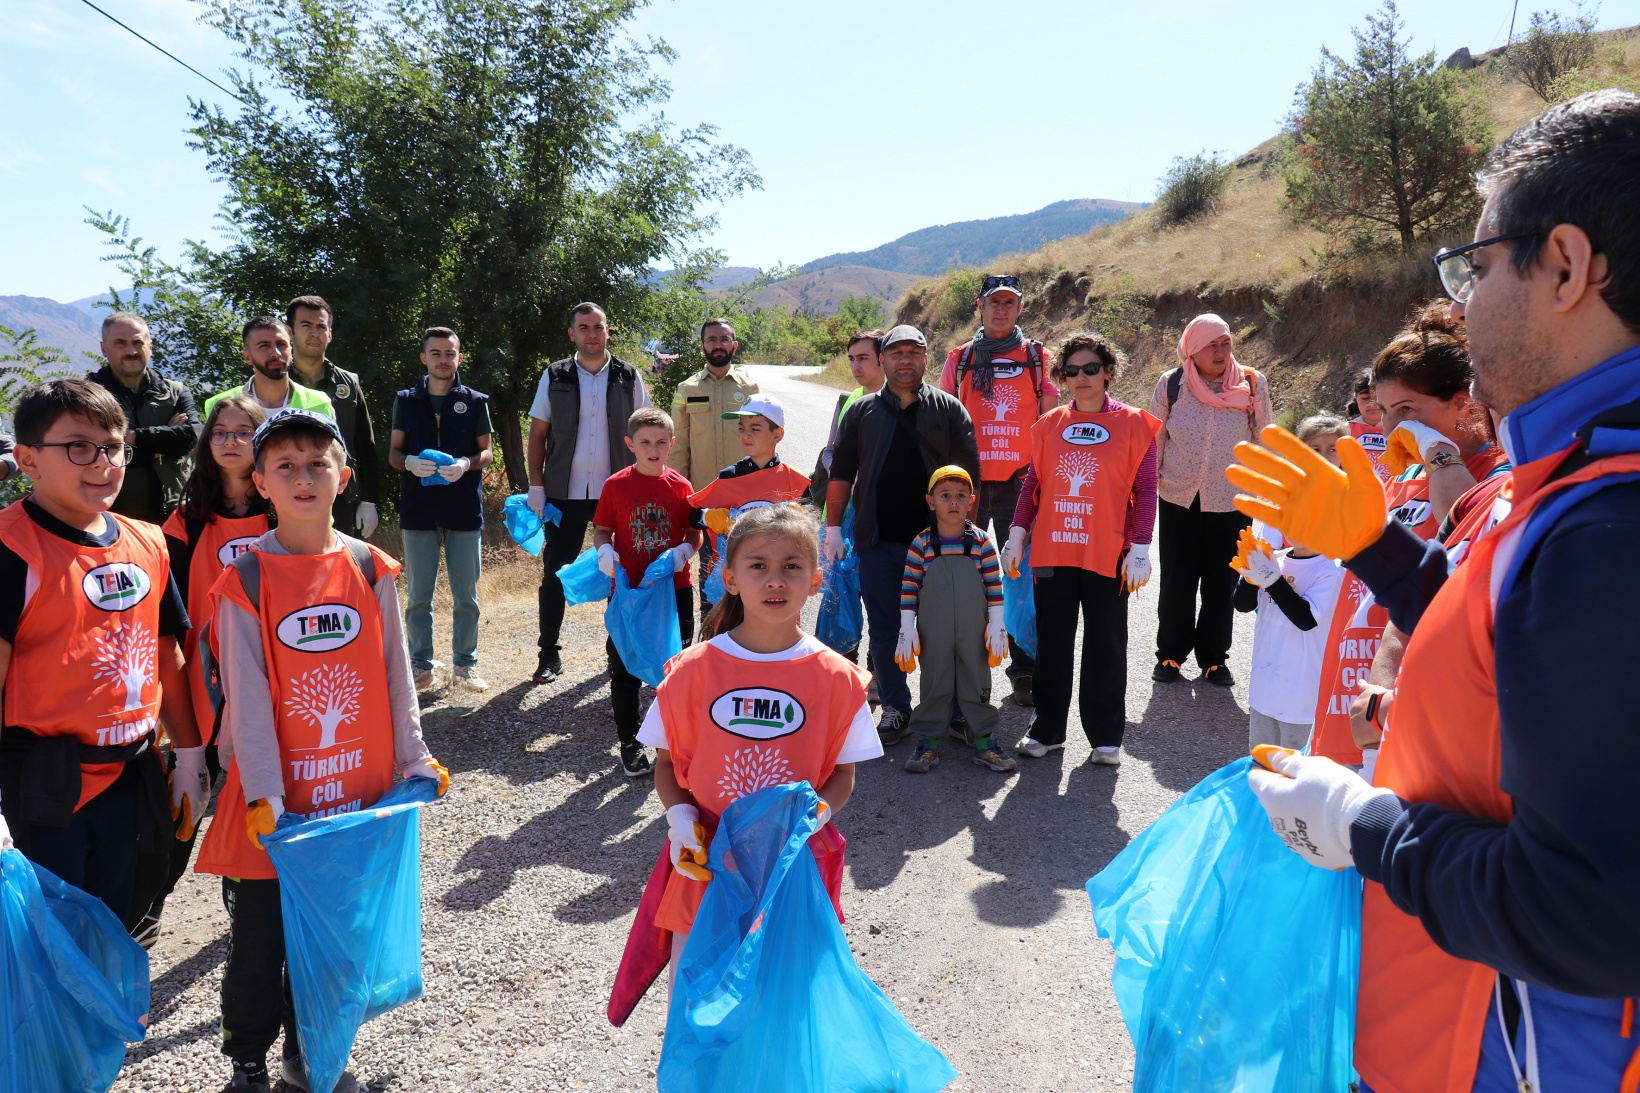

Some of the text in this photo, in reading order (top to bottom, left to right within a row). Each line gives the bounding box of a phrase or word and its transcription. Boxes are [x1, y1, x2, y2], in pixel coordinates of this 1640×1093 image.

[981, 423, 1020, 436] TÜRKİYE
[1072, 427, 1096, 437] TEMA
[991, 436, 1010, 449] ÇÖL
[1363, 436, 1385, 444] TEMA
[980, 451, 1020, 461] OLMASIN
[1064, 515, 1085, 530] ÇÖL
[1052, 531, 1089, 546] OLMASI
[297, 612, 342, 635] TEMA
[1341, 662, 1371, 692] ÇÖ
[732, 696, 782, 720] TEMA
[290, 748, 363, 781] TÜRKİYE
[311, 777, 345, 809] ÇÖL
